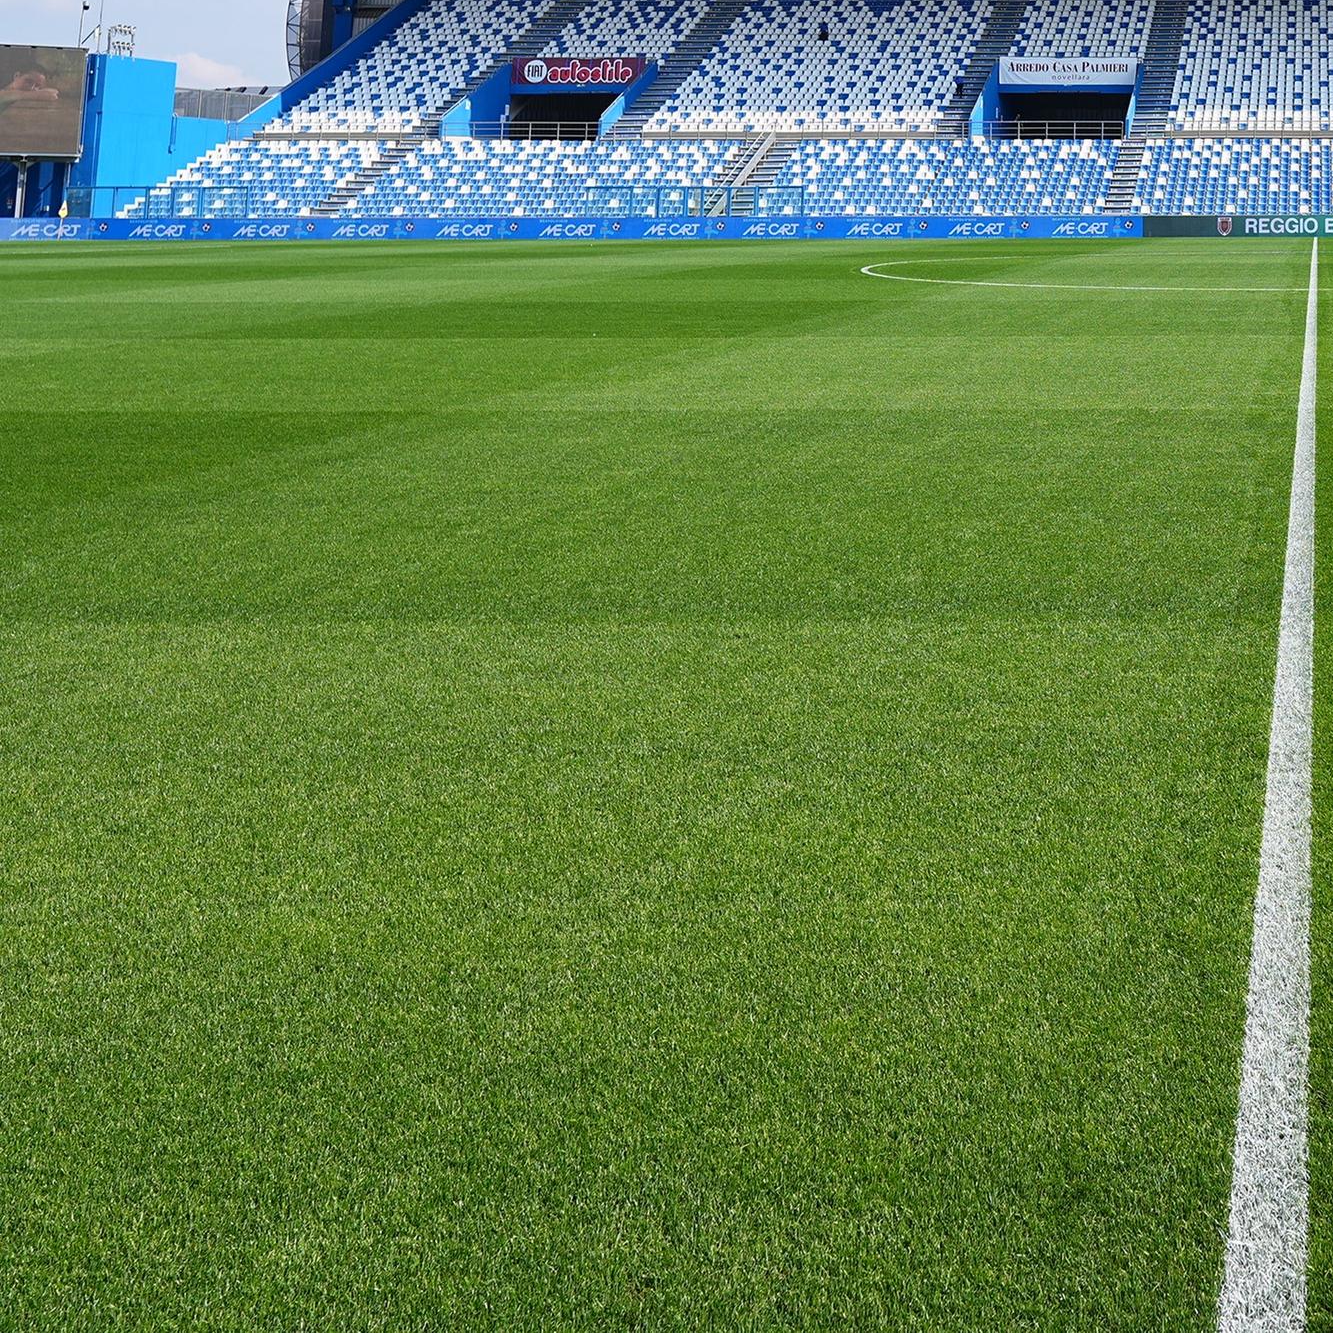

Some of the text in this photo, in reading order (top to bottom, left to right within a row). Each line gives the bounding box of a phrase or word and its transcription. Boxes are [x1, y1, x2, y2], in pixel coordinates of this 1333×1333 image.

[526, 64, 544, 78] FIAT
[1008, 61, 1129, 73] ARREDO CASA PALMIERI
[1244, 217, 1319, 234] REGGIO
